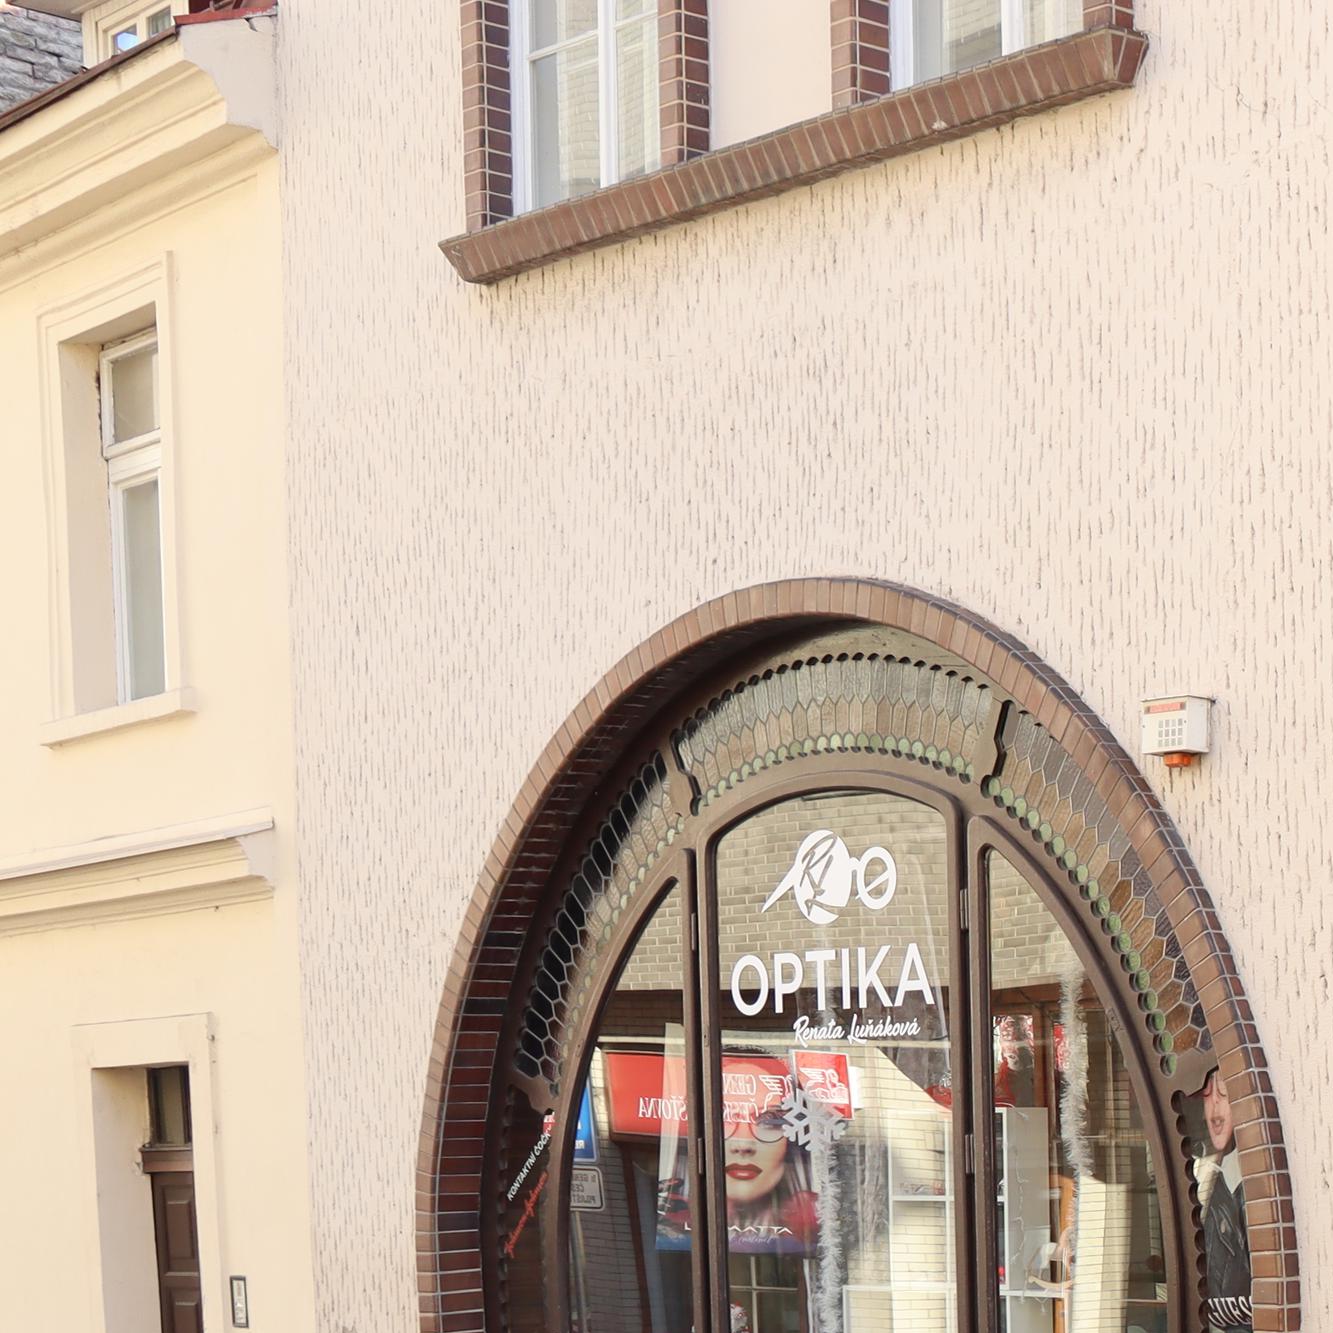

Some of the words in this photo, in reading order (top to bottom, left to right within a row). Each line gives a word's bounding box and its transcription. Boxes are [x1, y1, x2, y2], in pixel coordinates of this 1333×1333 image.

[731, 943, 936, 1016] OPTIKA
[793, 1015, 845, 1048] Renata
[847, 1013, 921, 1045] Luňáková
[533, 1131, 552, 1157] ČOČK
[1208, 1296, 1252, 1327] GUES
